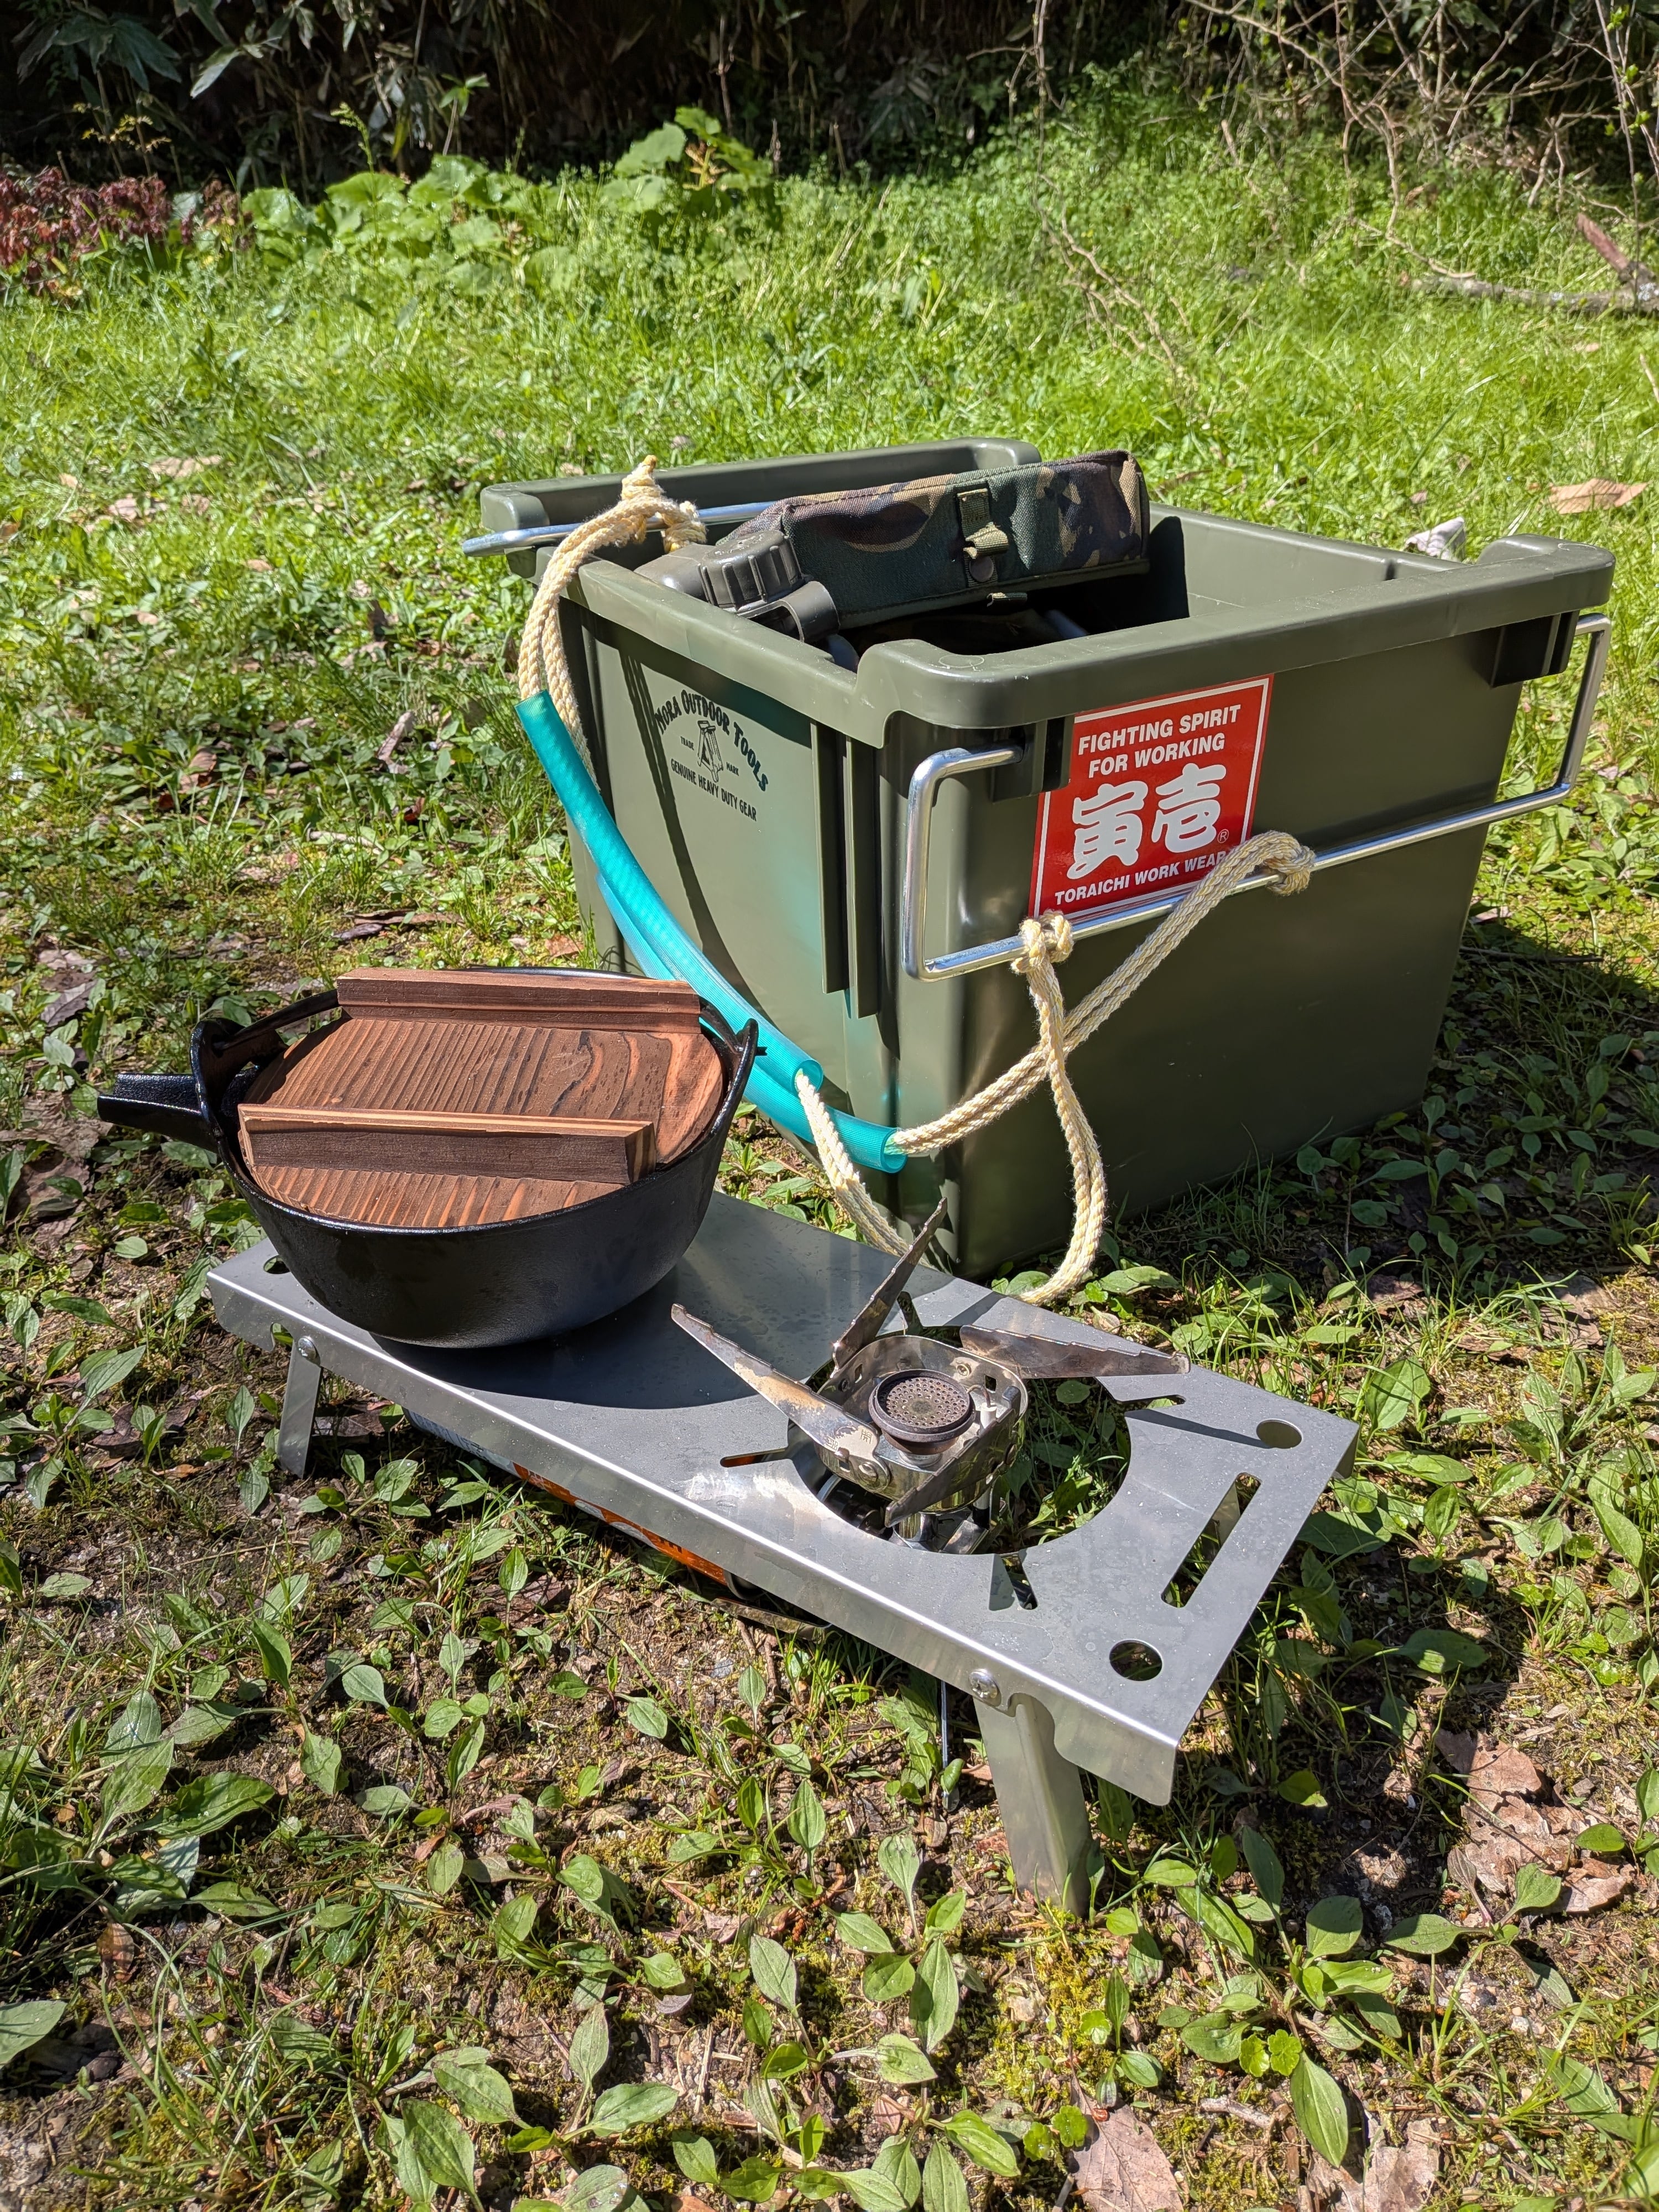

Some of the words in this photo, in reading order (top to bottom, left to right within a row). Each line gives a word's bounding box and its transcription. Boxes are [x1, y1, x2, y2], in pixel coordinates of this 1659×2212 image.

[680, 736, 695, 751] TRADE
[681, 689, 730, 736] OUTDOOR
[733, 721, 769, 792] TOOLS
[1078, 718, 1173, 755] FIGHTING
[1179, 704, 1241, 734] SPIRIT
[726, 761, 739, 776] MARK
[1088, 753, 1128, 779] FOR
[1134, 732, 1225, 768] WORKING
[671, 758, 697, 785] GENUINE
[698, 774, 719, 798] HEAVY
[721, 788, 738, 810] DUTY
[739, 799, 757, 822] GEAR
[1055, 875, 1130, 905] TORAICHI
[1135, 862, 1181, 885] WORK
